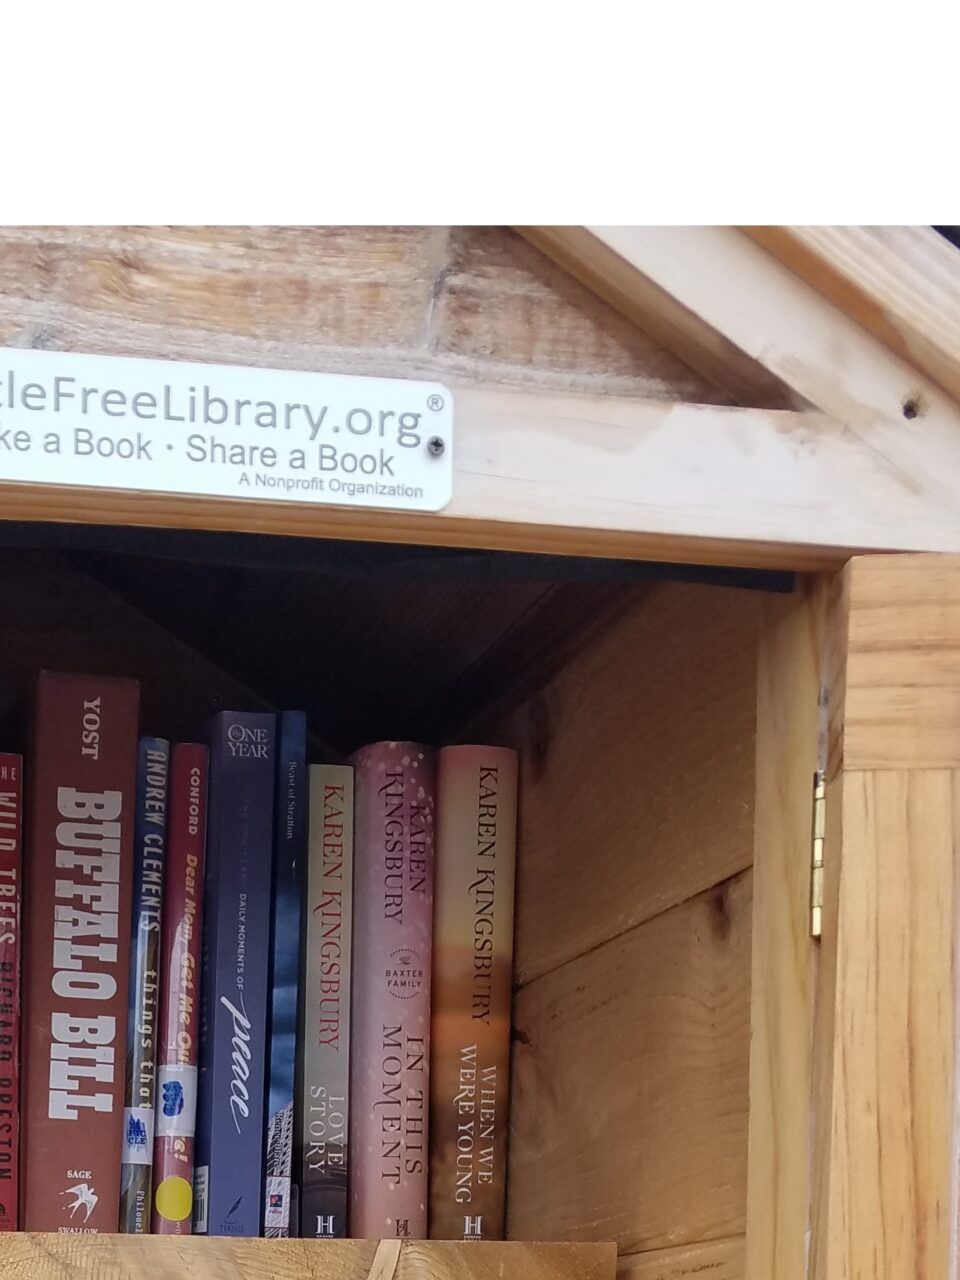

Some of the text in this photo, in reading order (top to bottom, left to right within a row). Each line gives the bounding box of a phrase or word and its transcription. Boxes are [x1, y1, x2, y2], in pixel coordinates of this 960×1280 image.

[43, 432, 61, 453] a
[73, 427, 154, 460] Book
[186, 434, 278, 467] Share
[288, 449, 307, 470] a
[319, 443, 395, 476] Book
[238, 473, 423, 498] A Nonprofit Organization
[81, 697, 101, 760] YOST
[227, 724, 269, 743] ONE
[228, 742, 269, 758] YEAR
[189, 767, 201, 836] CONFORD
[286, 761, 297, 839] Beast Stratton
[140, 750, 167, 933] ANDREW CLEMENTS
[378, 771, 404, 925] KINGSBURY
[409, 803, 427, 894] KAREN
[237, 893, 247, 922] DAILY
[314, 784, 345, 1051] KAREN KINGSBURY
[468, 765, 498, 1026] KAREN KINGSBURY
[47, 787, 123, 1121] BUFFALO BILL
[178, 854, 198, 1027] Dear Me
[236, 924, 247, 976] MOMENTS
[386, 970, 423, 978] BAXTER
[137, 970, 157, 1049] things
[387, 980, 423, 988] FAMILY
[220, 996, 251, 1135] peace
[373, 1024, 403, 1185] MOMENT
[405, 1036, 424, 1174] IN THIS
[307, 1086, 328, 1175] STORY
[327, 1096, 345, 1167] LOVE
[452, 1044, 478, 1204] WERE YOUNG
[477, 1065, 497, 1185] WHEN WE
[67, 1170, 92, 1180] SAGE
